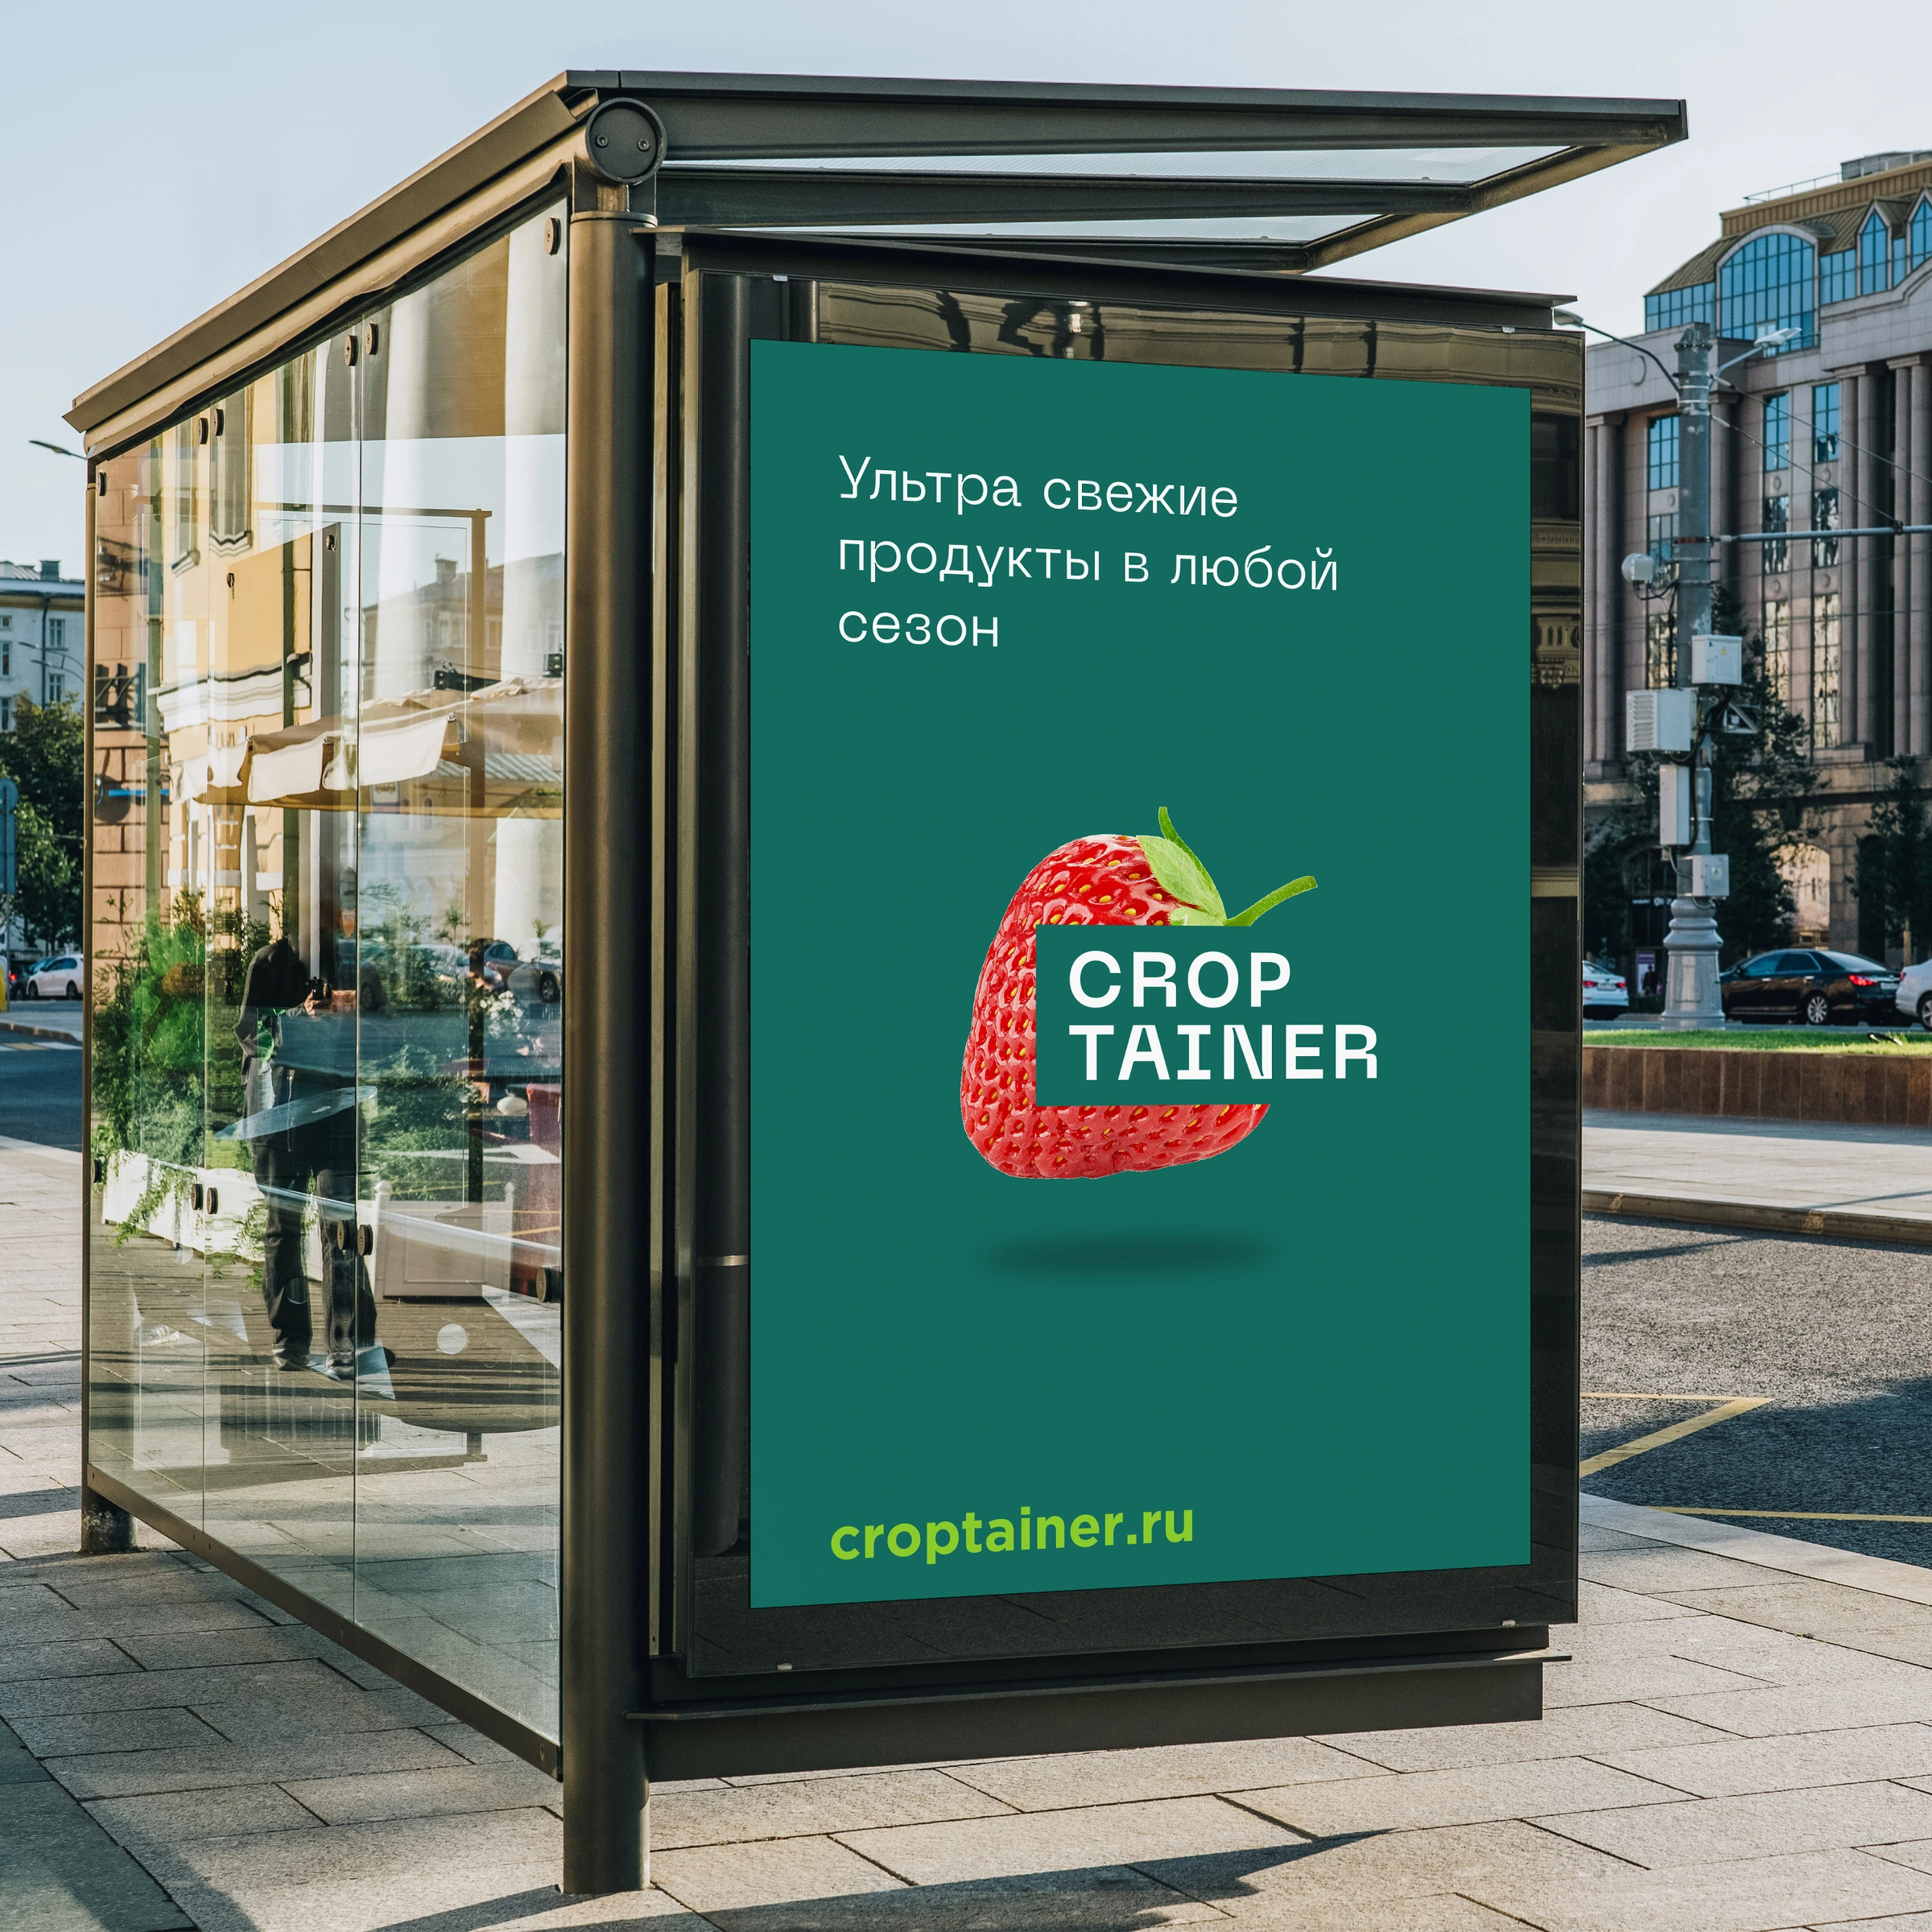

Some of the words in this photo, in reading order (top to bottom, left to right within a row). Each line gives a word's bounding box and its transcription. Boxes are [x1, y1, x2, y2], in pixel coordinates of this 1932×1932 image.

[838, 455, 1022, 516] Ультра
[1043, 477, 1238, 518] свежие
[839, 539, 1100, 588] продукты
[1125, 551, 1150, 583] в
[1170, 544, 1338, 591] любой
[838, 609, 999, 647] сезон
[1069, 950, 1291, 1009] CROP
[1068, 1024, 1377, 1081] TAINER
[831, 1506, 1193, 1565] croptainer.ru
